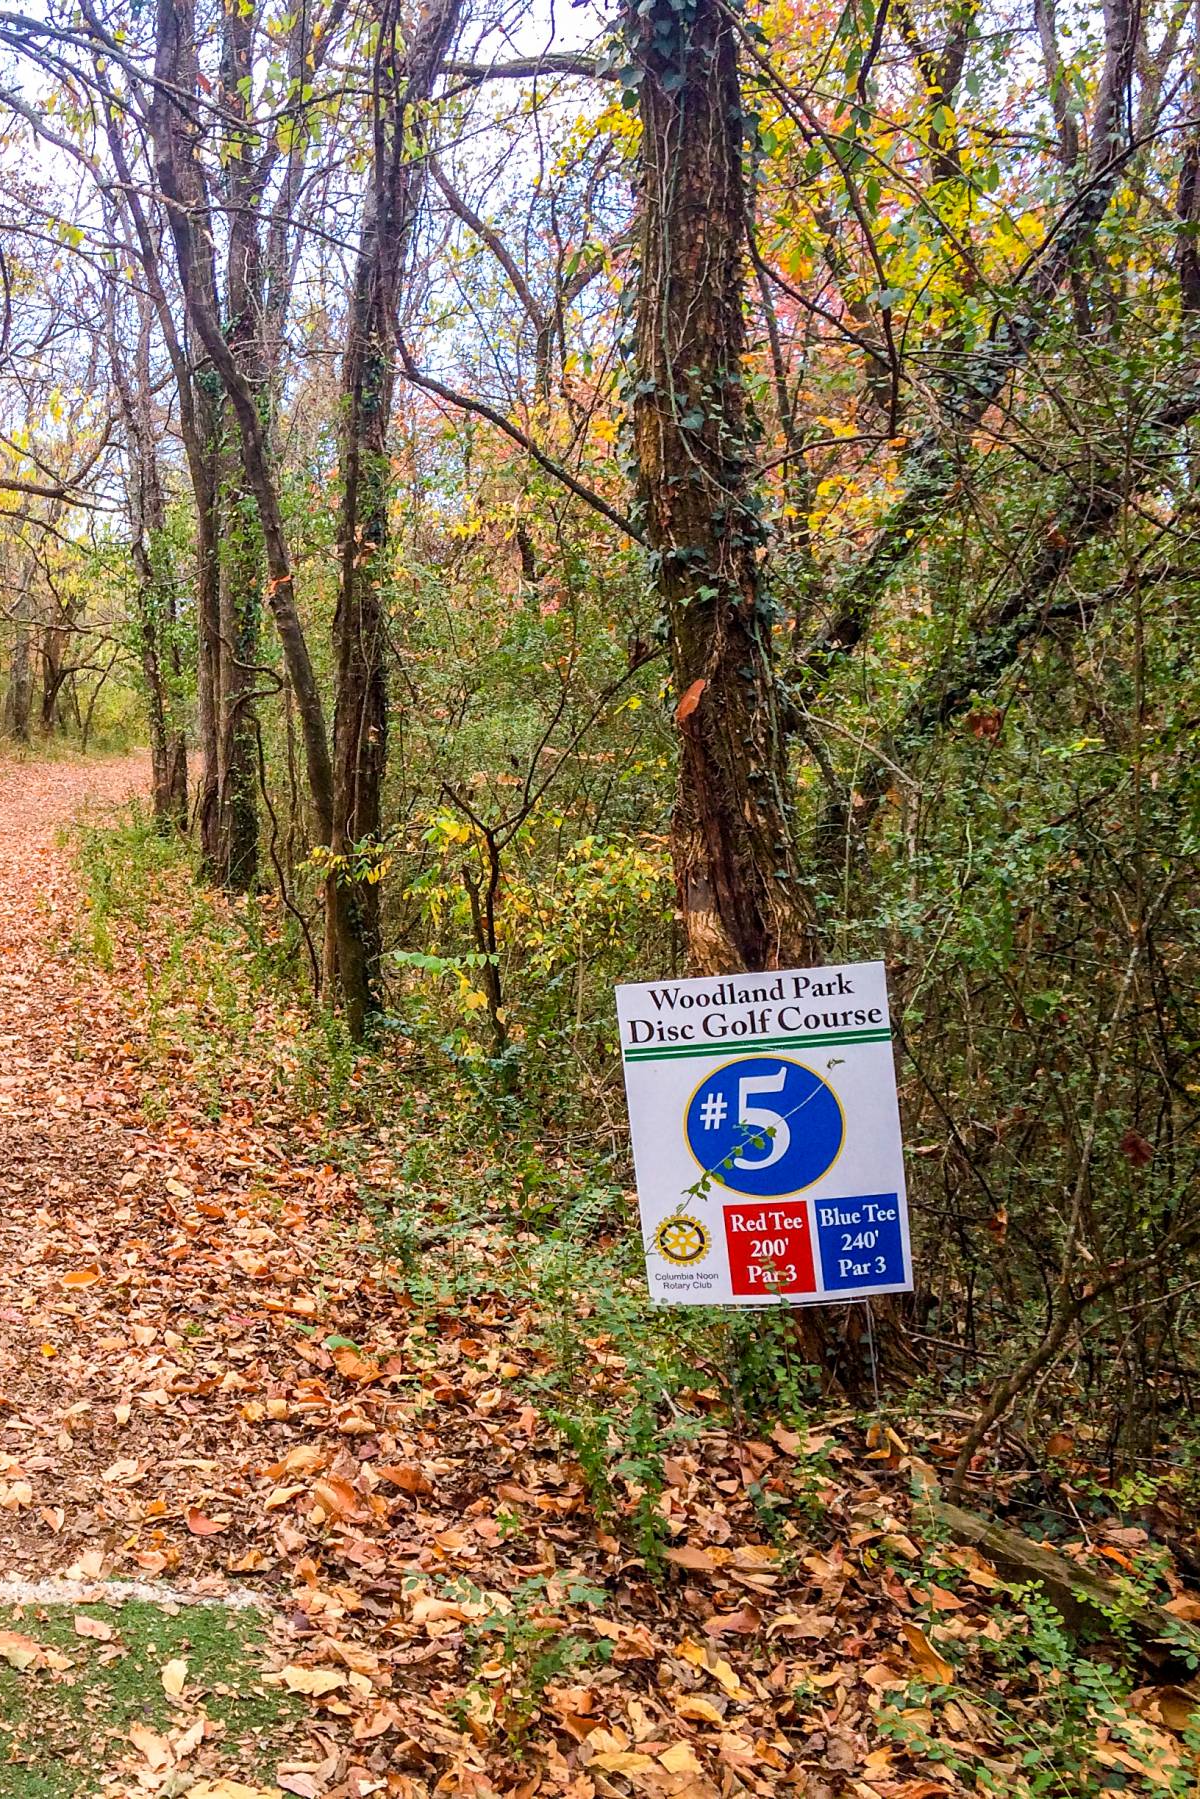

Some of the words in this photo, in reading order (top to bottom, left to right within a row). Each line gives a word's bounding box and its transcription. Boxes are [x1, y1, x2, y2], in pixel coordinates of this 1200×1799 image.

[648, 979, 785, 1011] Woodland
[792, 972, 855, 999] Park
[627, 1019, 695, 1044] Disc
[702, 1008, 772, 1038] Golf
[778, 1005, 883, 1031] Course
[700, 1066, 790, 1170] #5
[730, 1212, 767, 1232] Red
[768, 1211, 803, 1230] Tee
[819, 1206, 861, 1227] Blue
[862, 1204, 897, 1223] Tee
[750, 1239, 789, 1257] 200'
[840, 1230, 879, 1251] 240'
[654, 1273, 694, 1281] Columbia
[696, 1272, 719, 1280] Noon
[746, 1265, 780, 1283] Par
[784, 1264, 797, 1282] 3
[838, 1258, 872, 1277] Par
[874, 1256, 887, 1274] 3
[663, 1281, 690, 1290] Rotary
[693, 1280, 712, 1289] Club
